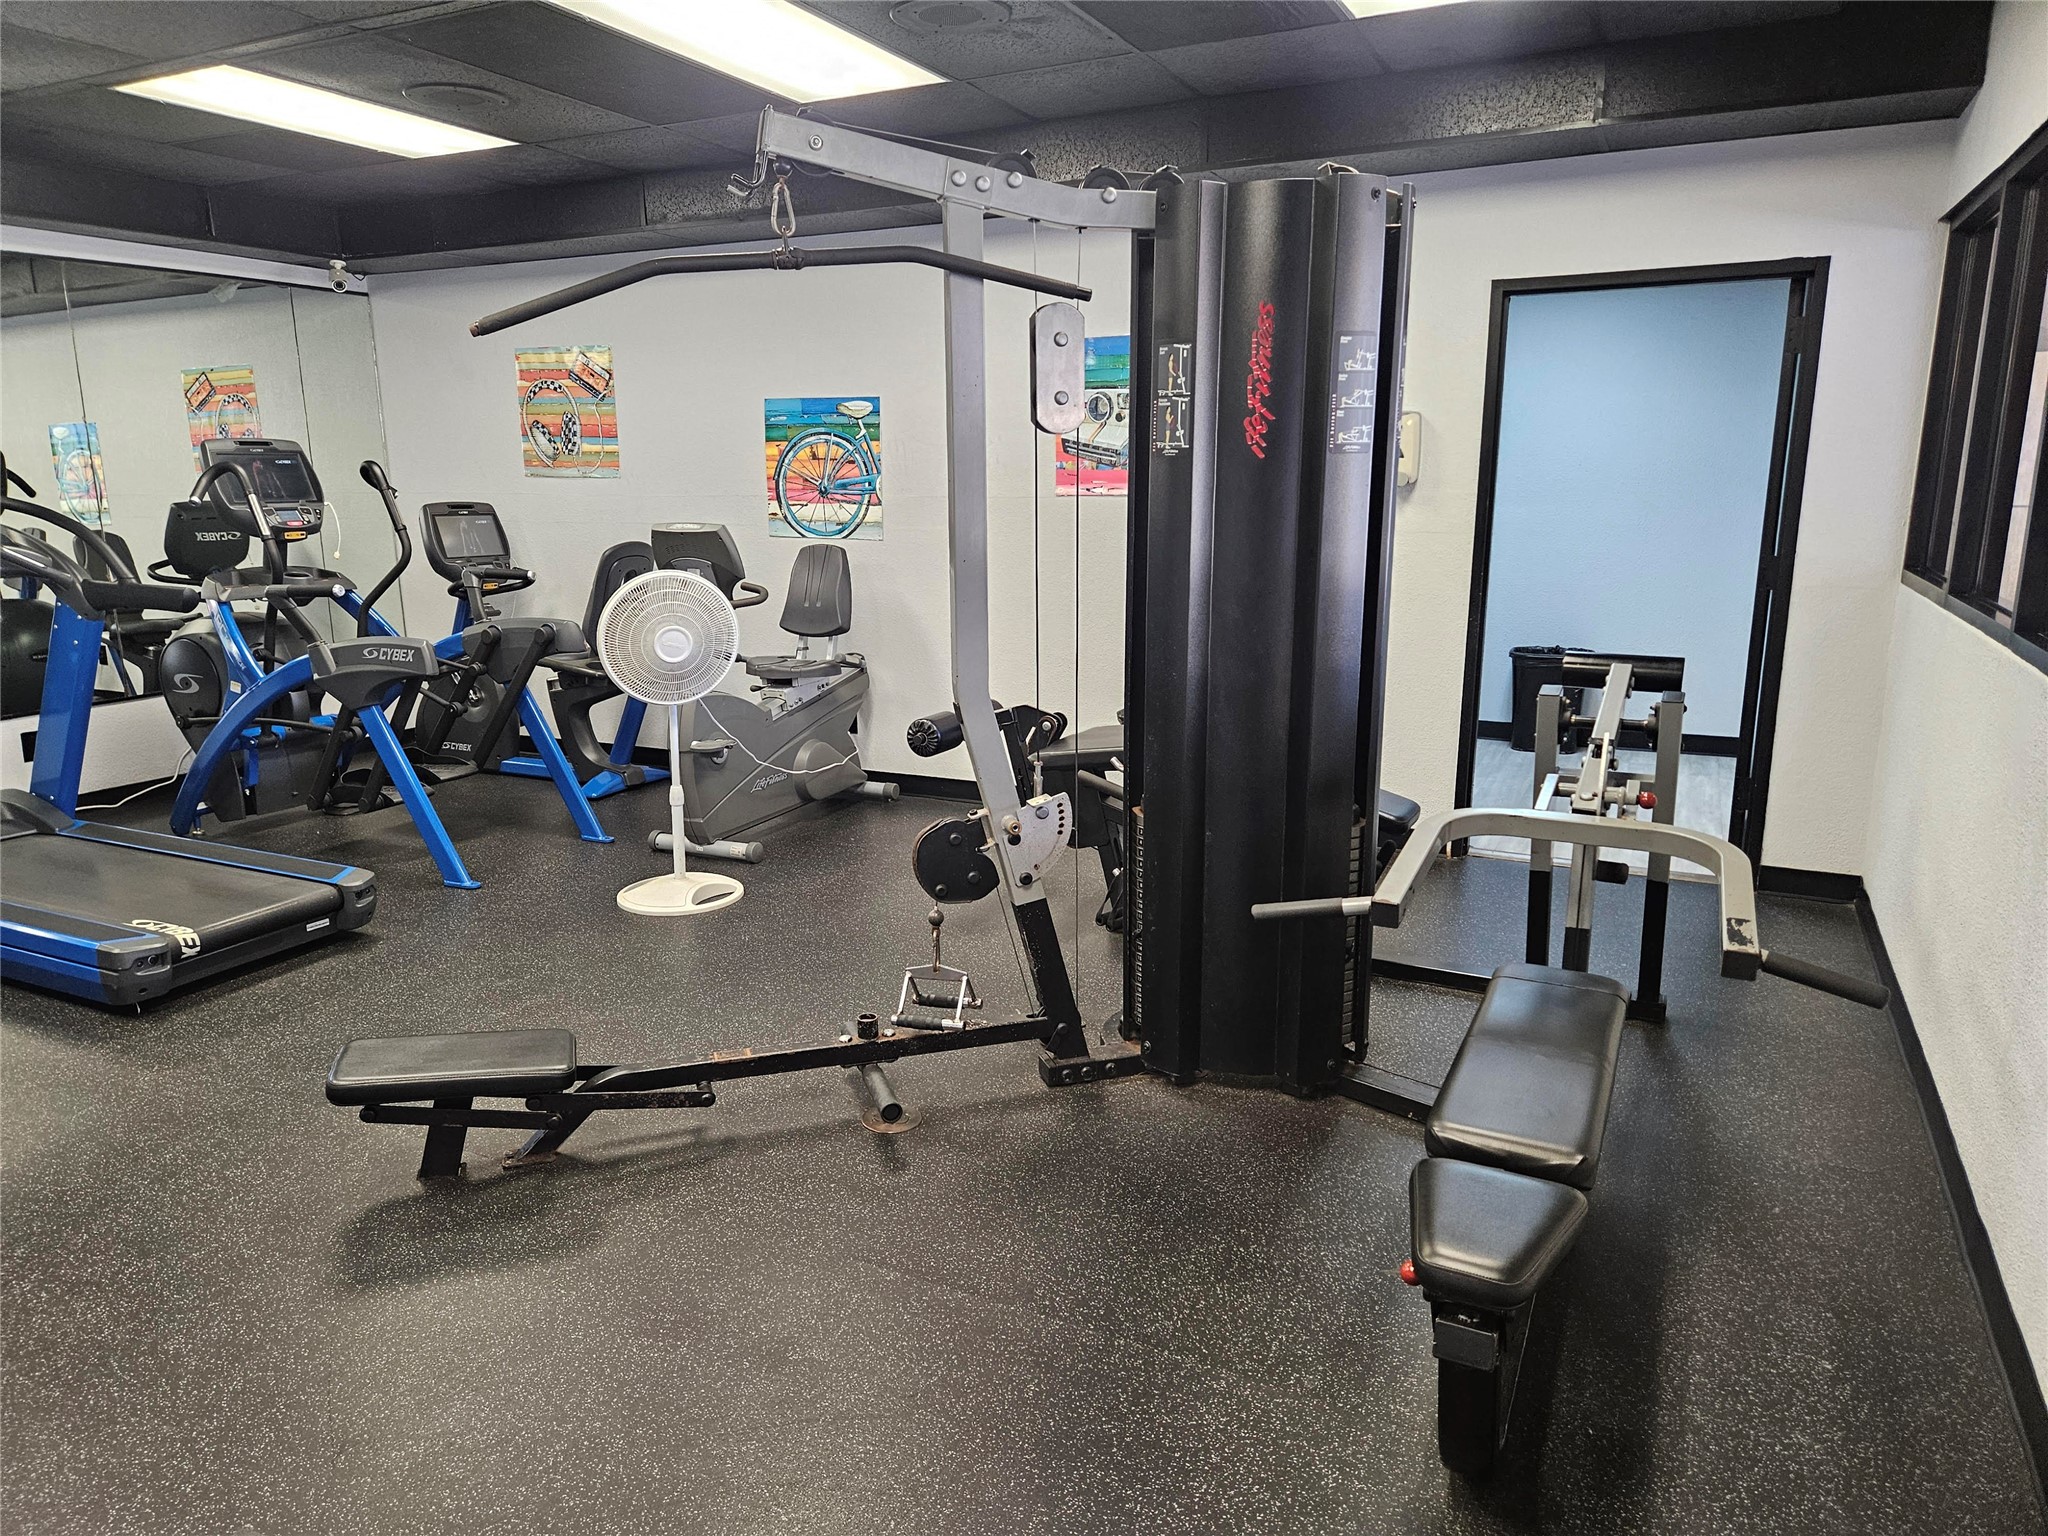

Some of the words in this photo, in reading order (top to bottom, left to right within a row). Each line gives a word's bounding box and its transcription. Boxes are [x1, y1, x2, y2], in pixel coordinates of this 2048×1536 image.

[378, 647, 415, 662] CYBEX
[450, 742, 472, 752] CYBEX
[145, 922, 202, 960] CYBEX
